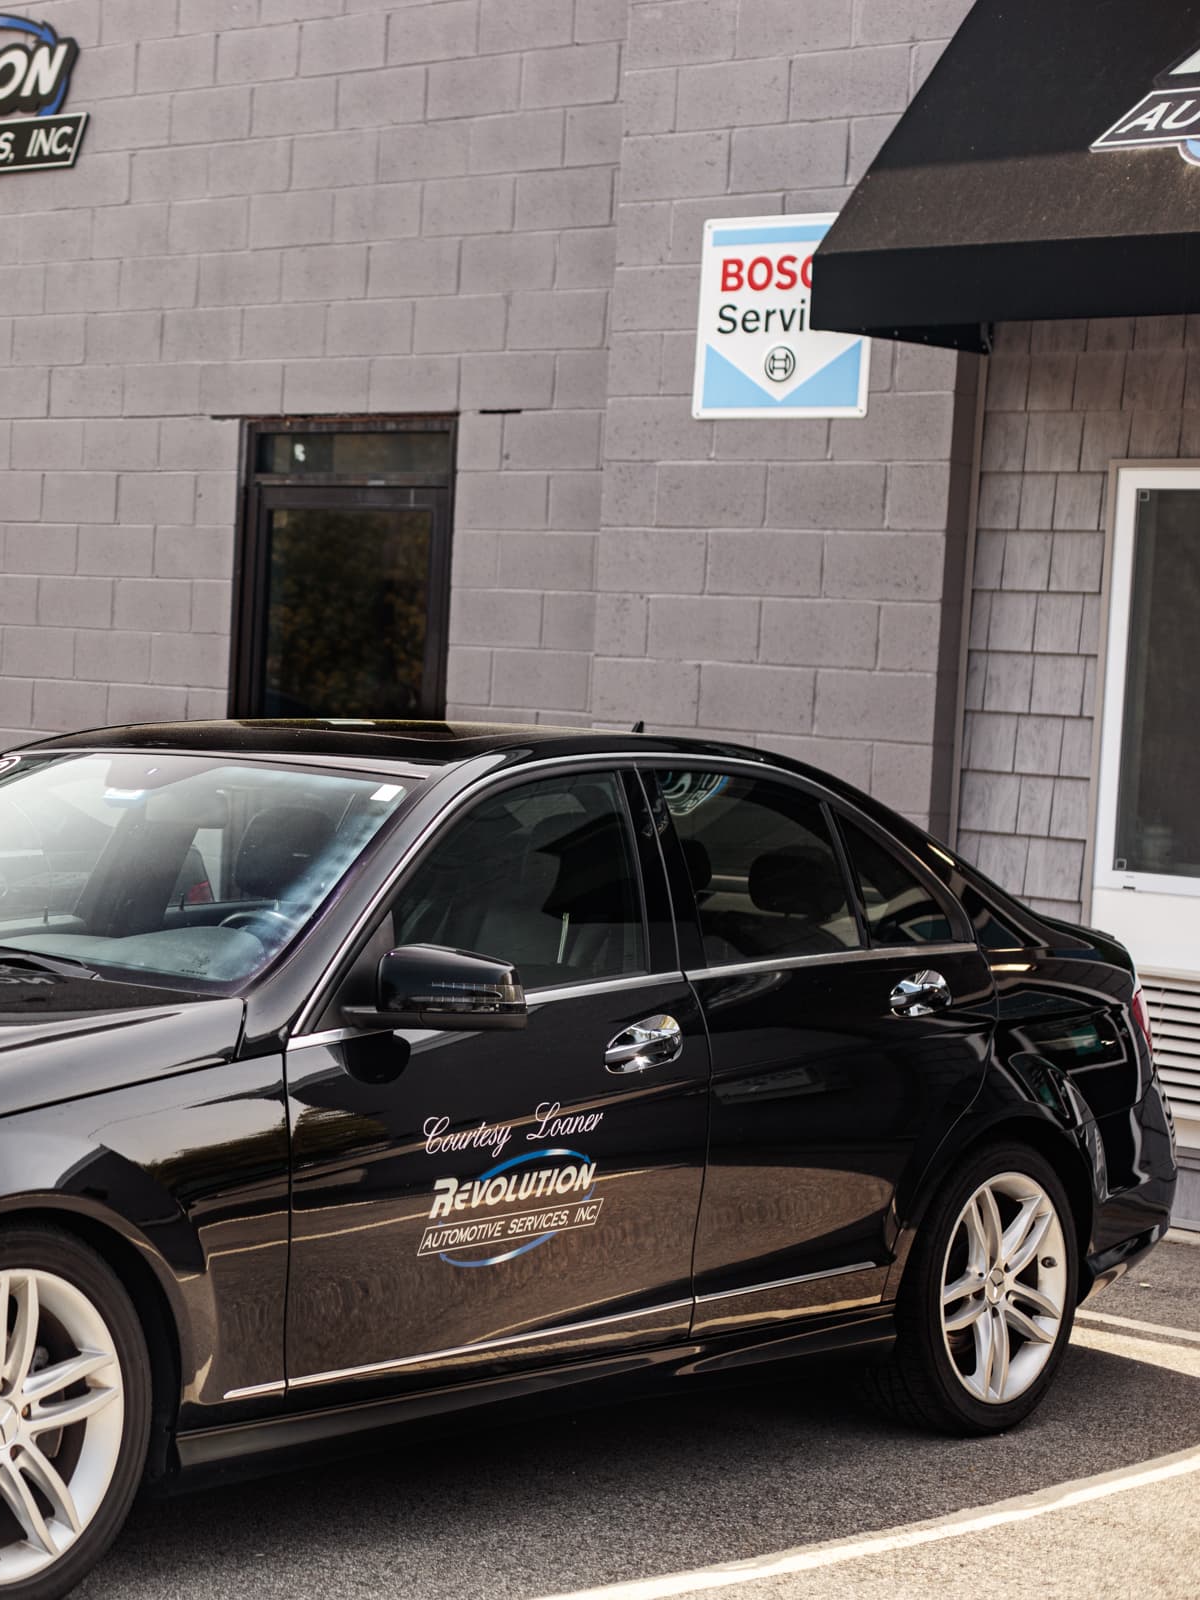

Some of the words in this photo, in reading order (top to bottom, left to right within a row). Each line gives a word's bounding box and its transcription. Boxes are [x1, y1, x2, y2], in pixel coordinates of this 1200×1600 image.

[26, 125, 74, 158] INC.
[720, 254, 813, 293] BOS
[716, 298, 806, 335] Servi
[423, 1116, 512, 1158] Courtesy
[526, 1101, 604, 1140] Loaner
[429, 1162, 597, 1220] REVOLUTION
[421, 1220, 505, 1250] AUTOMOTIVE
[507, 1209, 570, 1235] SERVICES,
[573, 1205, 597, 1223] INC.
